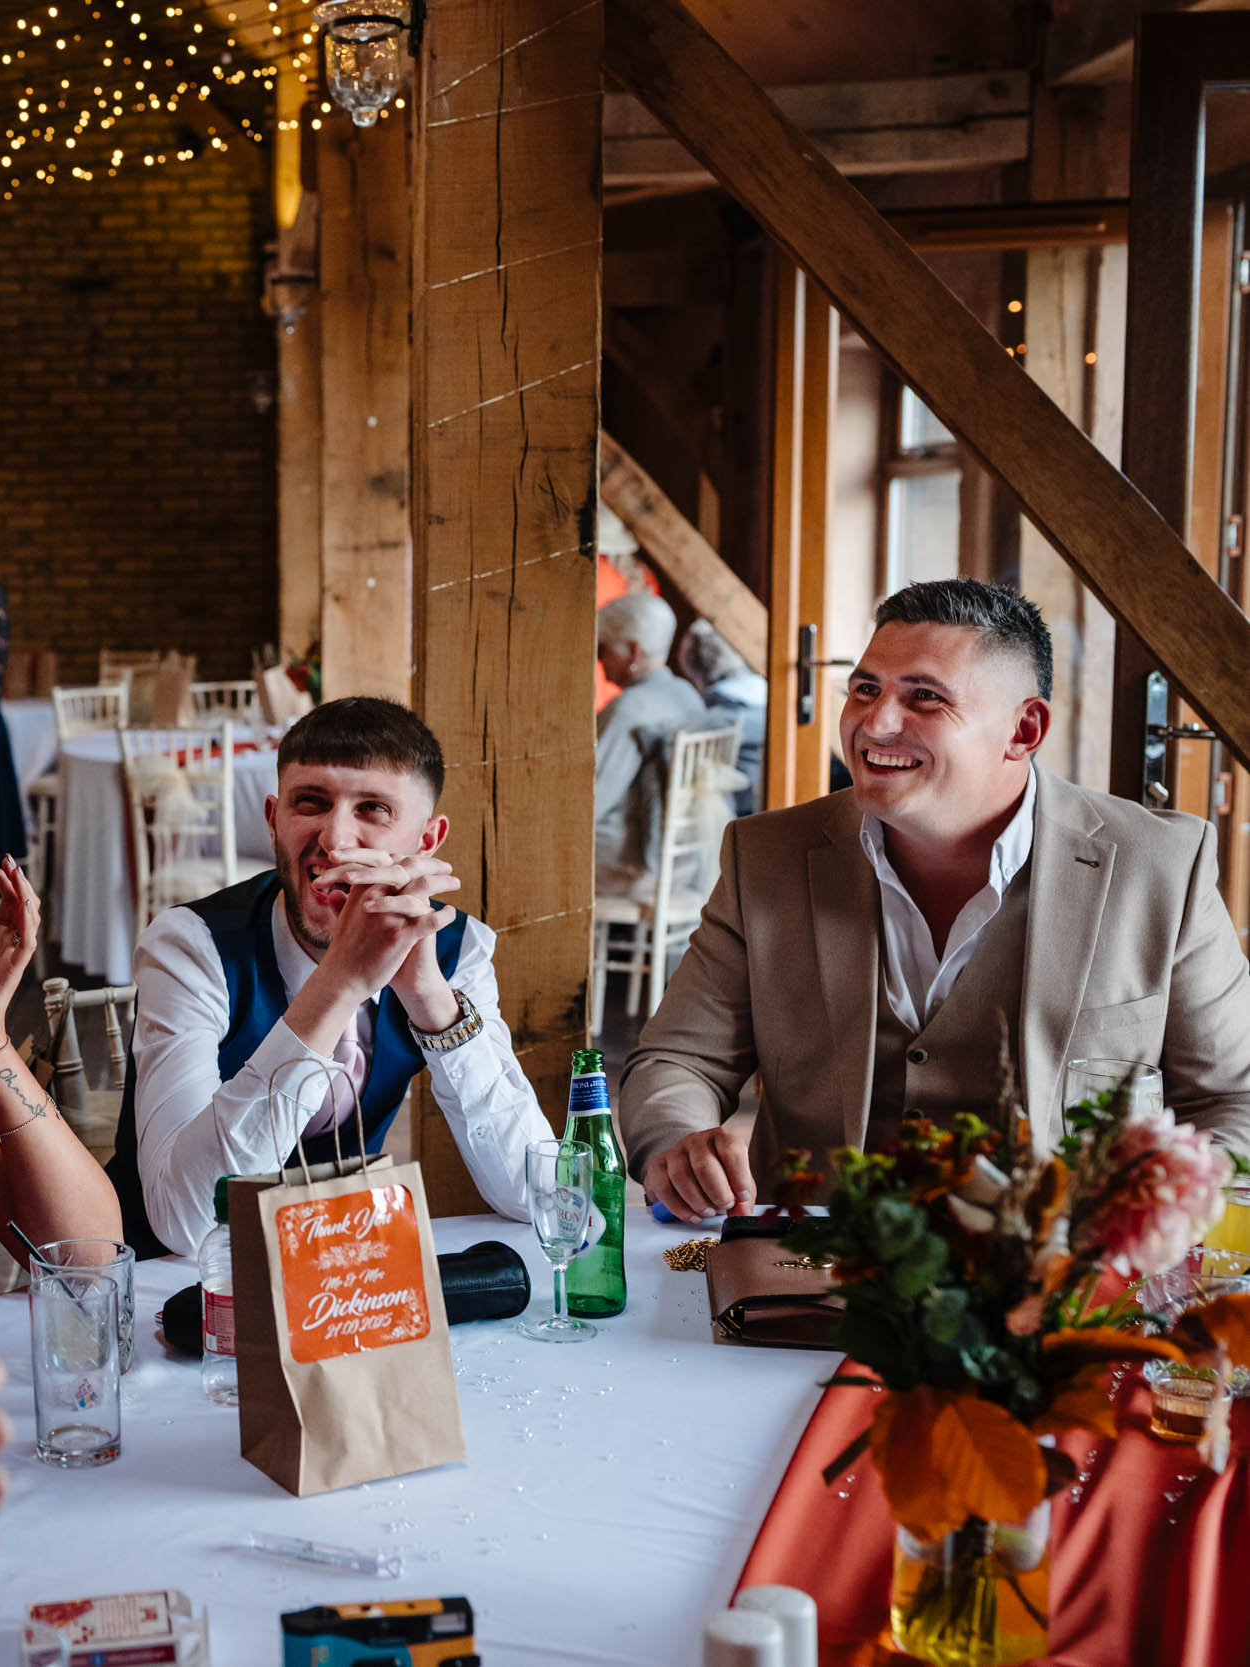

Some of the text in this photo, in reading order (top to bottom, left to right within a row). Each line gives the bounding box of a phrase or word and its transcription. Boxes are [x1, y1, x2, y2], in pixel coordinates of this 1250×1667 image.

[301, 1207, 393, 1245] Thank You
[302, 1287, 409, 1331] Dickinson
